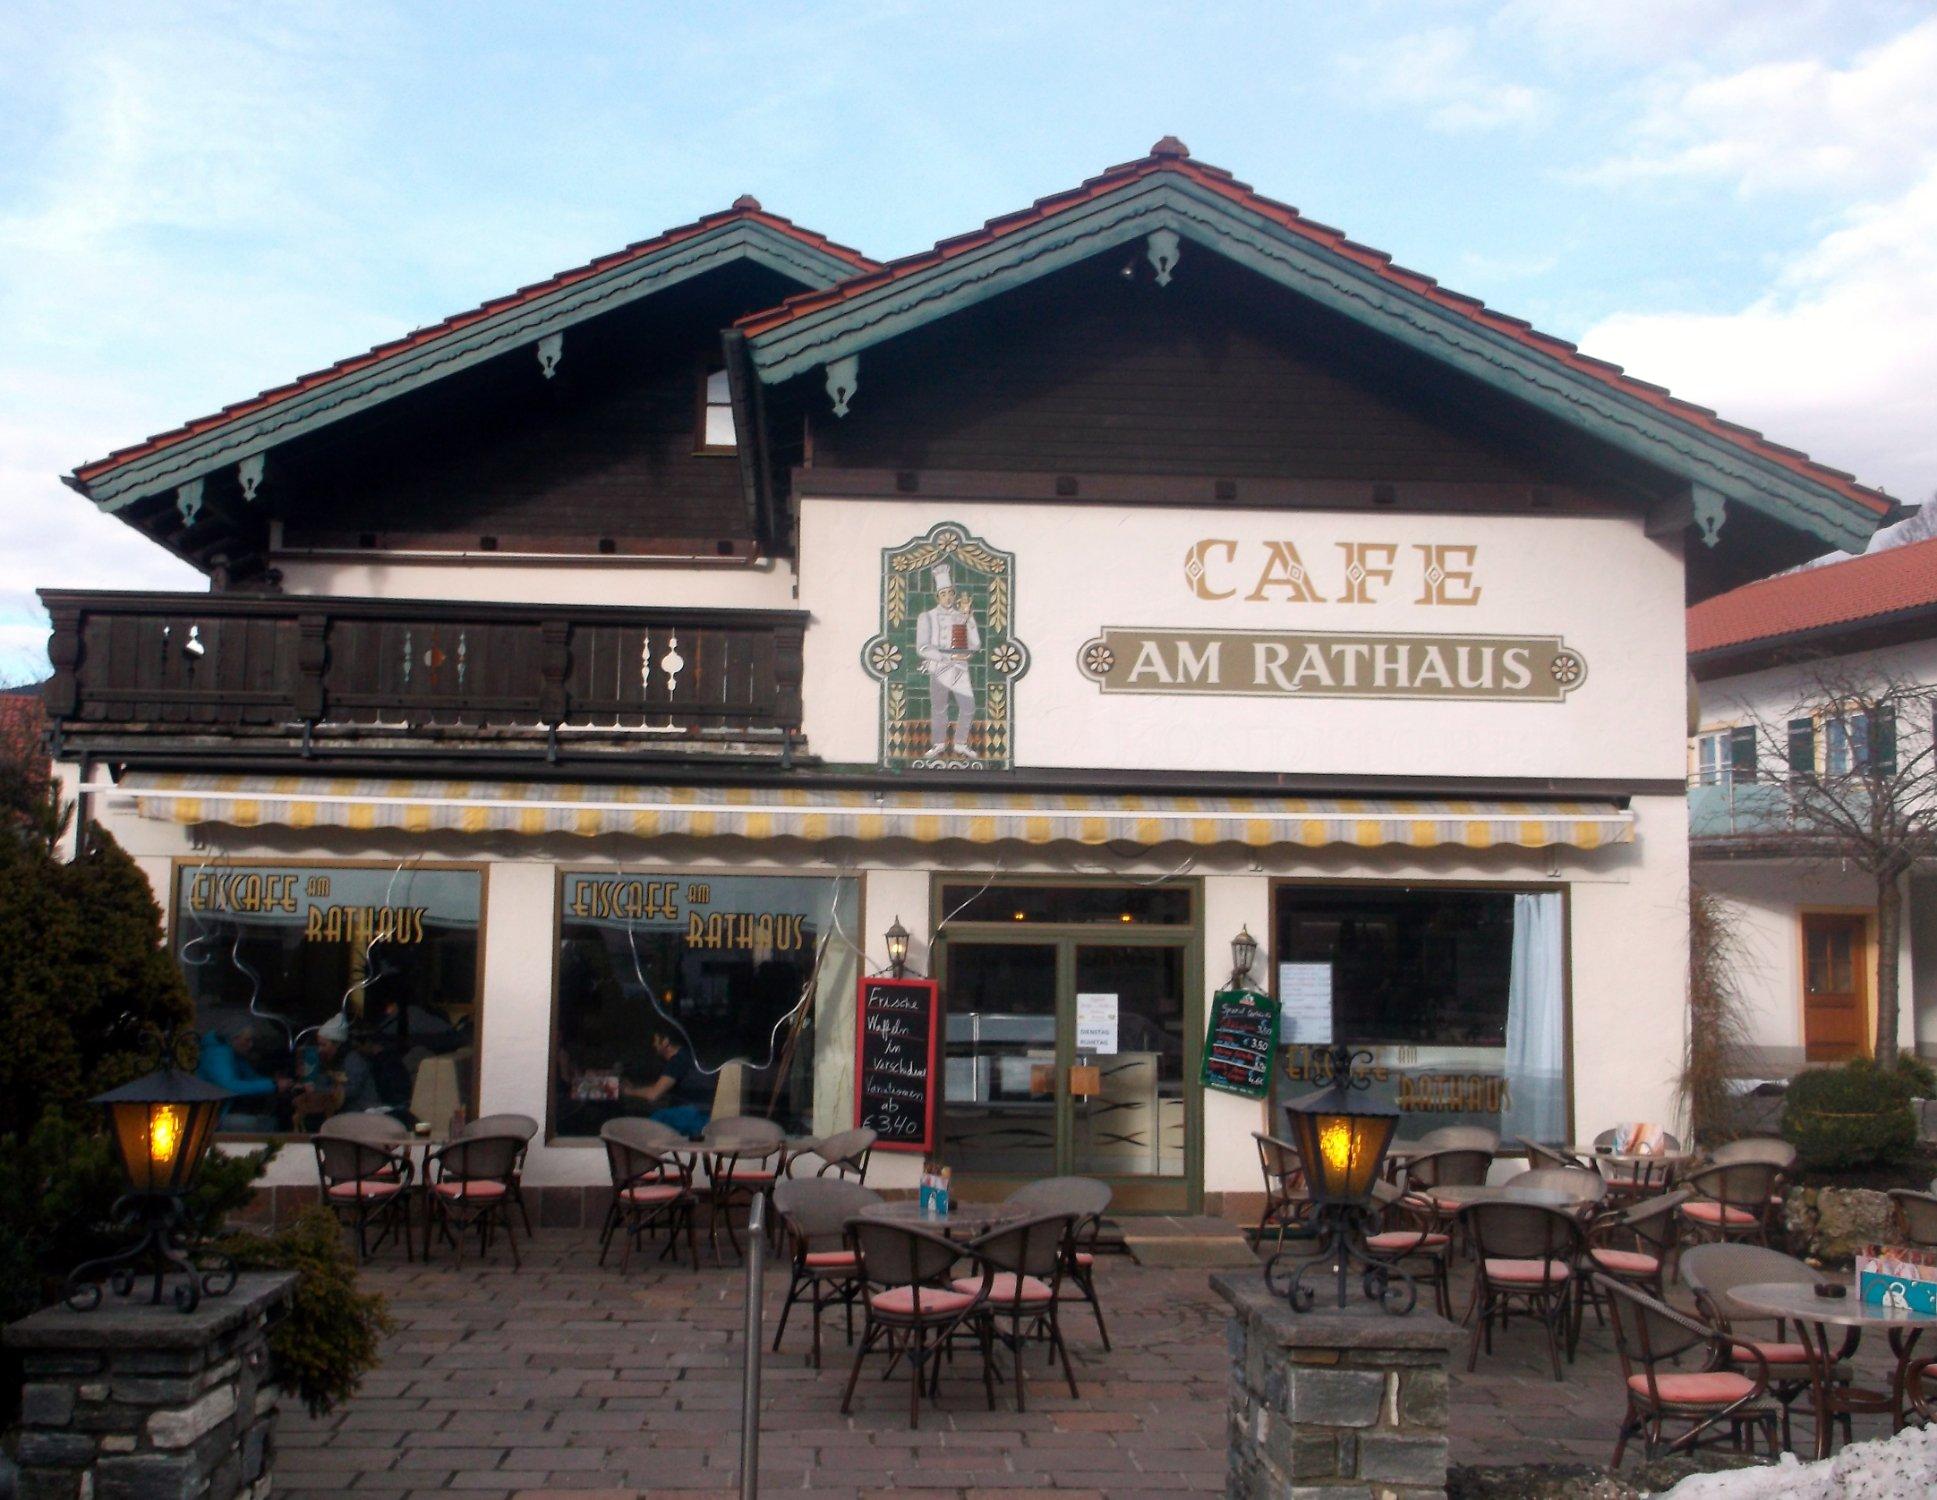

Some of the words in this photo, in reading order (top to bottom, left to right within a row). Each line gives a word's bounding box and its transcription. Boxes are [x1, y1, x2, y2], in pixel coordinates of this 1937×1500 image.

[1184, 538, 1482, 607] CAFE
[1126, 639, 1221, 685] AM
[1253, 641, 1532, 692] RATHAUS
[190, 873, 298, 912] EISCAFE
[304, 875, 332, 898] AM
[571, 880, 679, 920] EISCAFE
[685, 883, 711, 904] AM
[303, 903, 428, 945] RATHAUS
[685, 911, 807, 951] RATHAUS
[880, 1097, 899, 1113] ab
[1395, 1072, 1512, 1113] RATHAUS
[878, 1114, 918, 1135] 3,40
